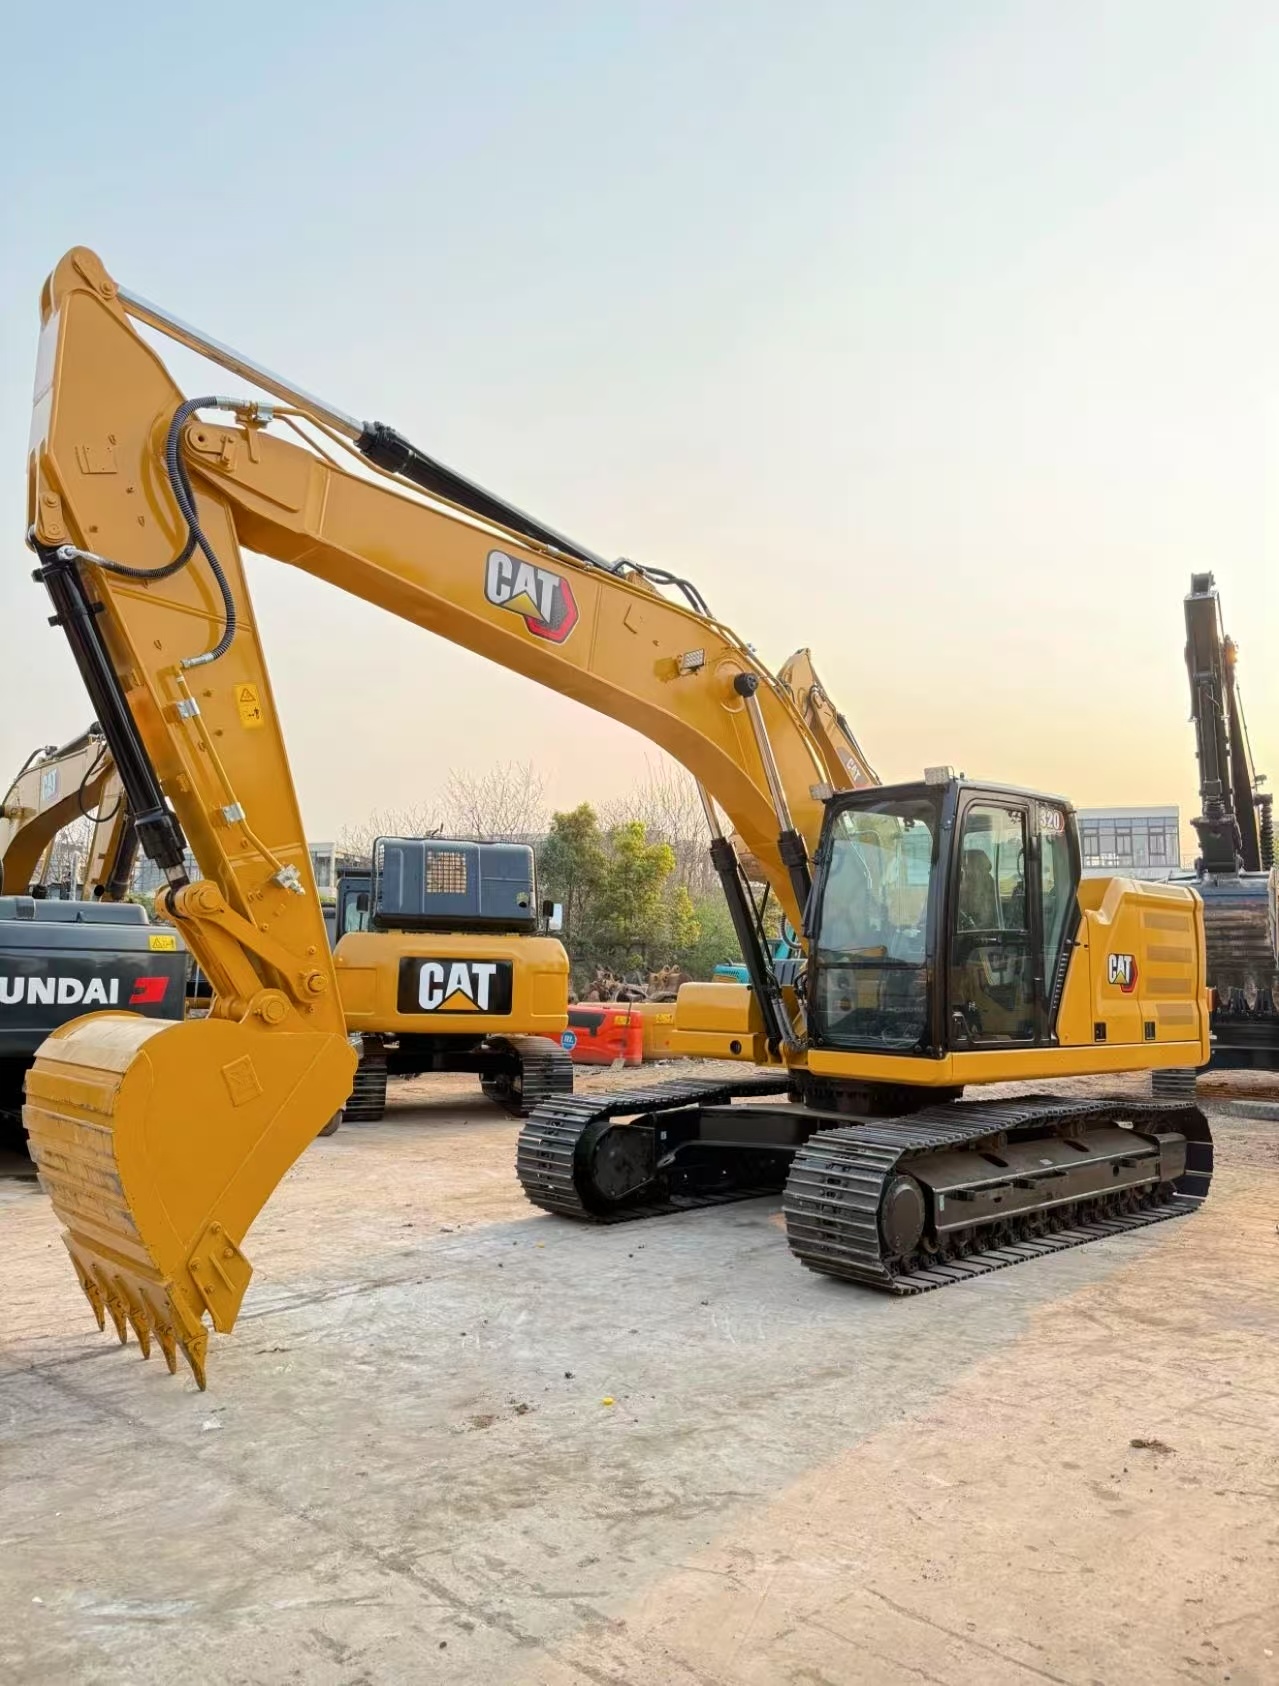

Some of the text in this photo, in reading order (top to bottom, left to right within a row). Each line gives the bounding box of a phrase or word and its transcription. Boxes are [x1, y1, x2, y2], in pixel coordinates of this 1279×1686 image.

[486, 551, 560, 624] CAT
[846, 758, 861, 782] CAT
[1040, 810, 1060, 830] 320
[1109, 954, 1132, 984] CAT
[419, 962, 497, 1011] CAT
